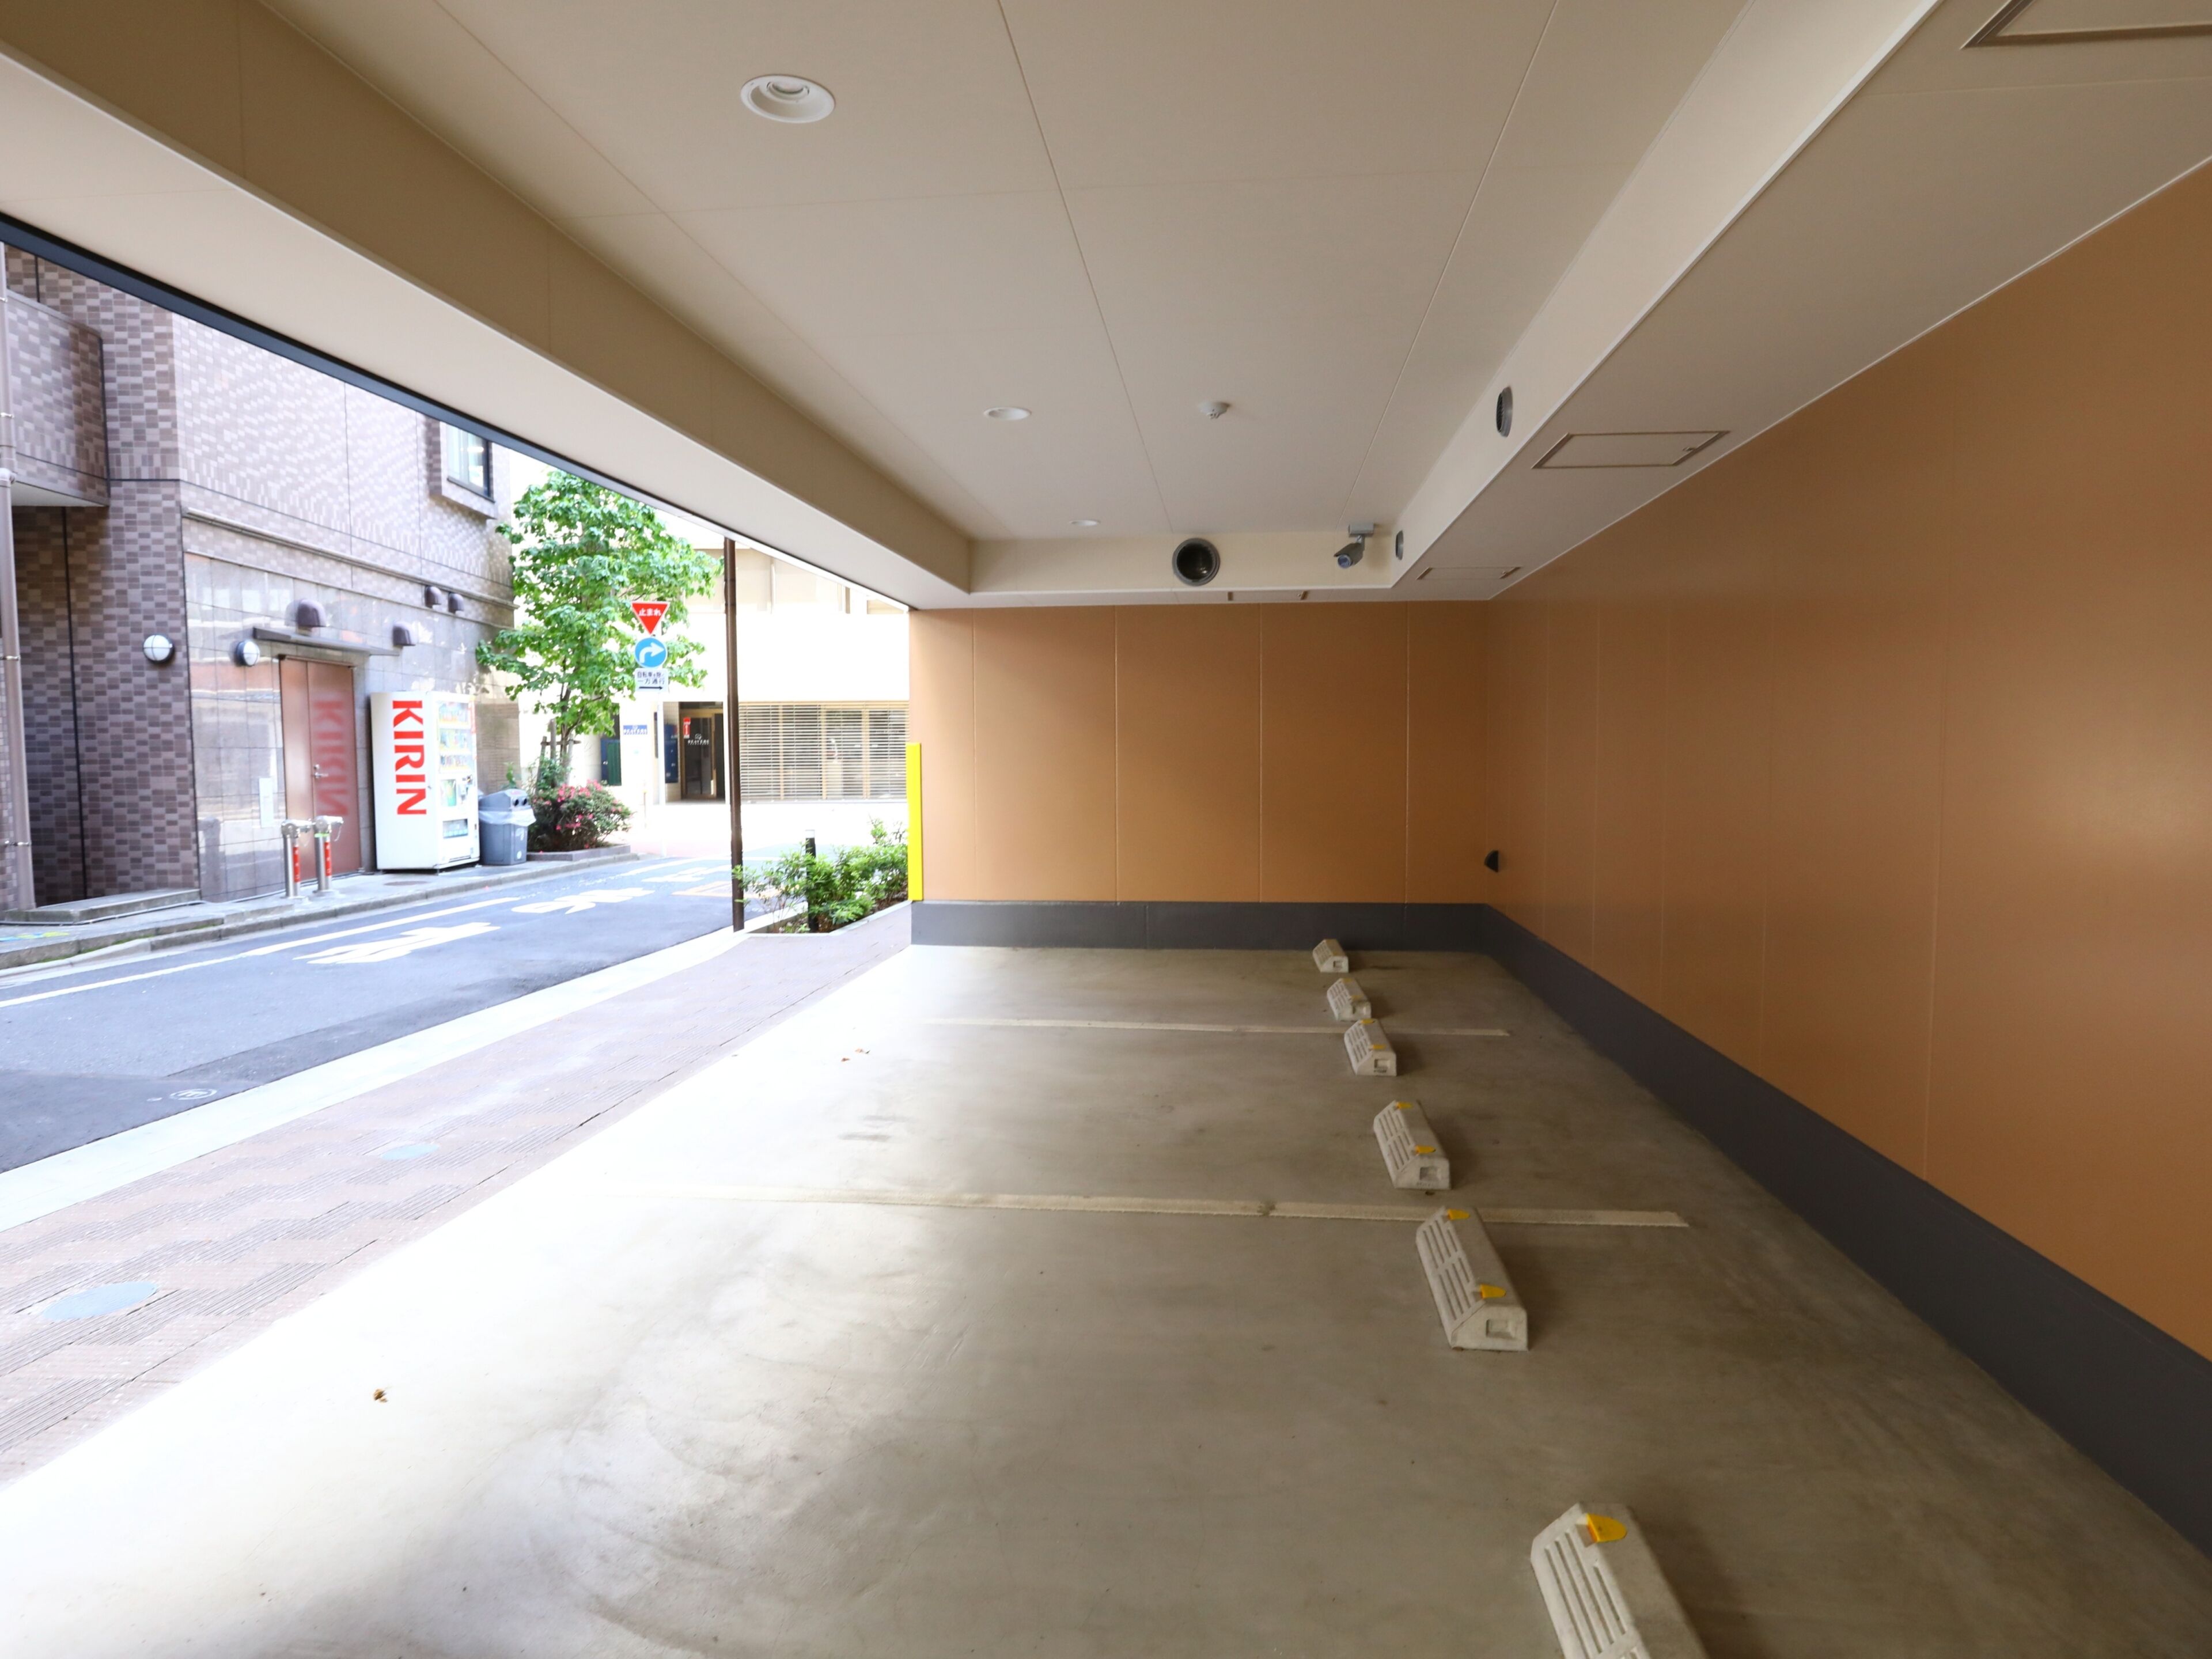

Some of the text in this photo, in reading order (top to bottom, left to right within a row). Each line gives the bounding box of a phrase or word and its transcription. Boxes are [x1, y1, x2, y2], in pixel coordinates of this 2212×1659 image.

[638, 608, 662, 616] 止まれ
[392, 700, 427, 815] KIRIN
